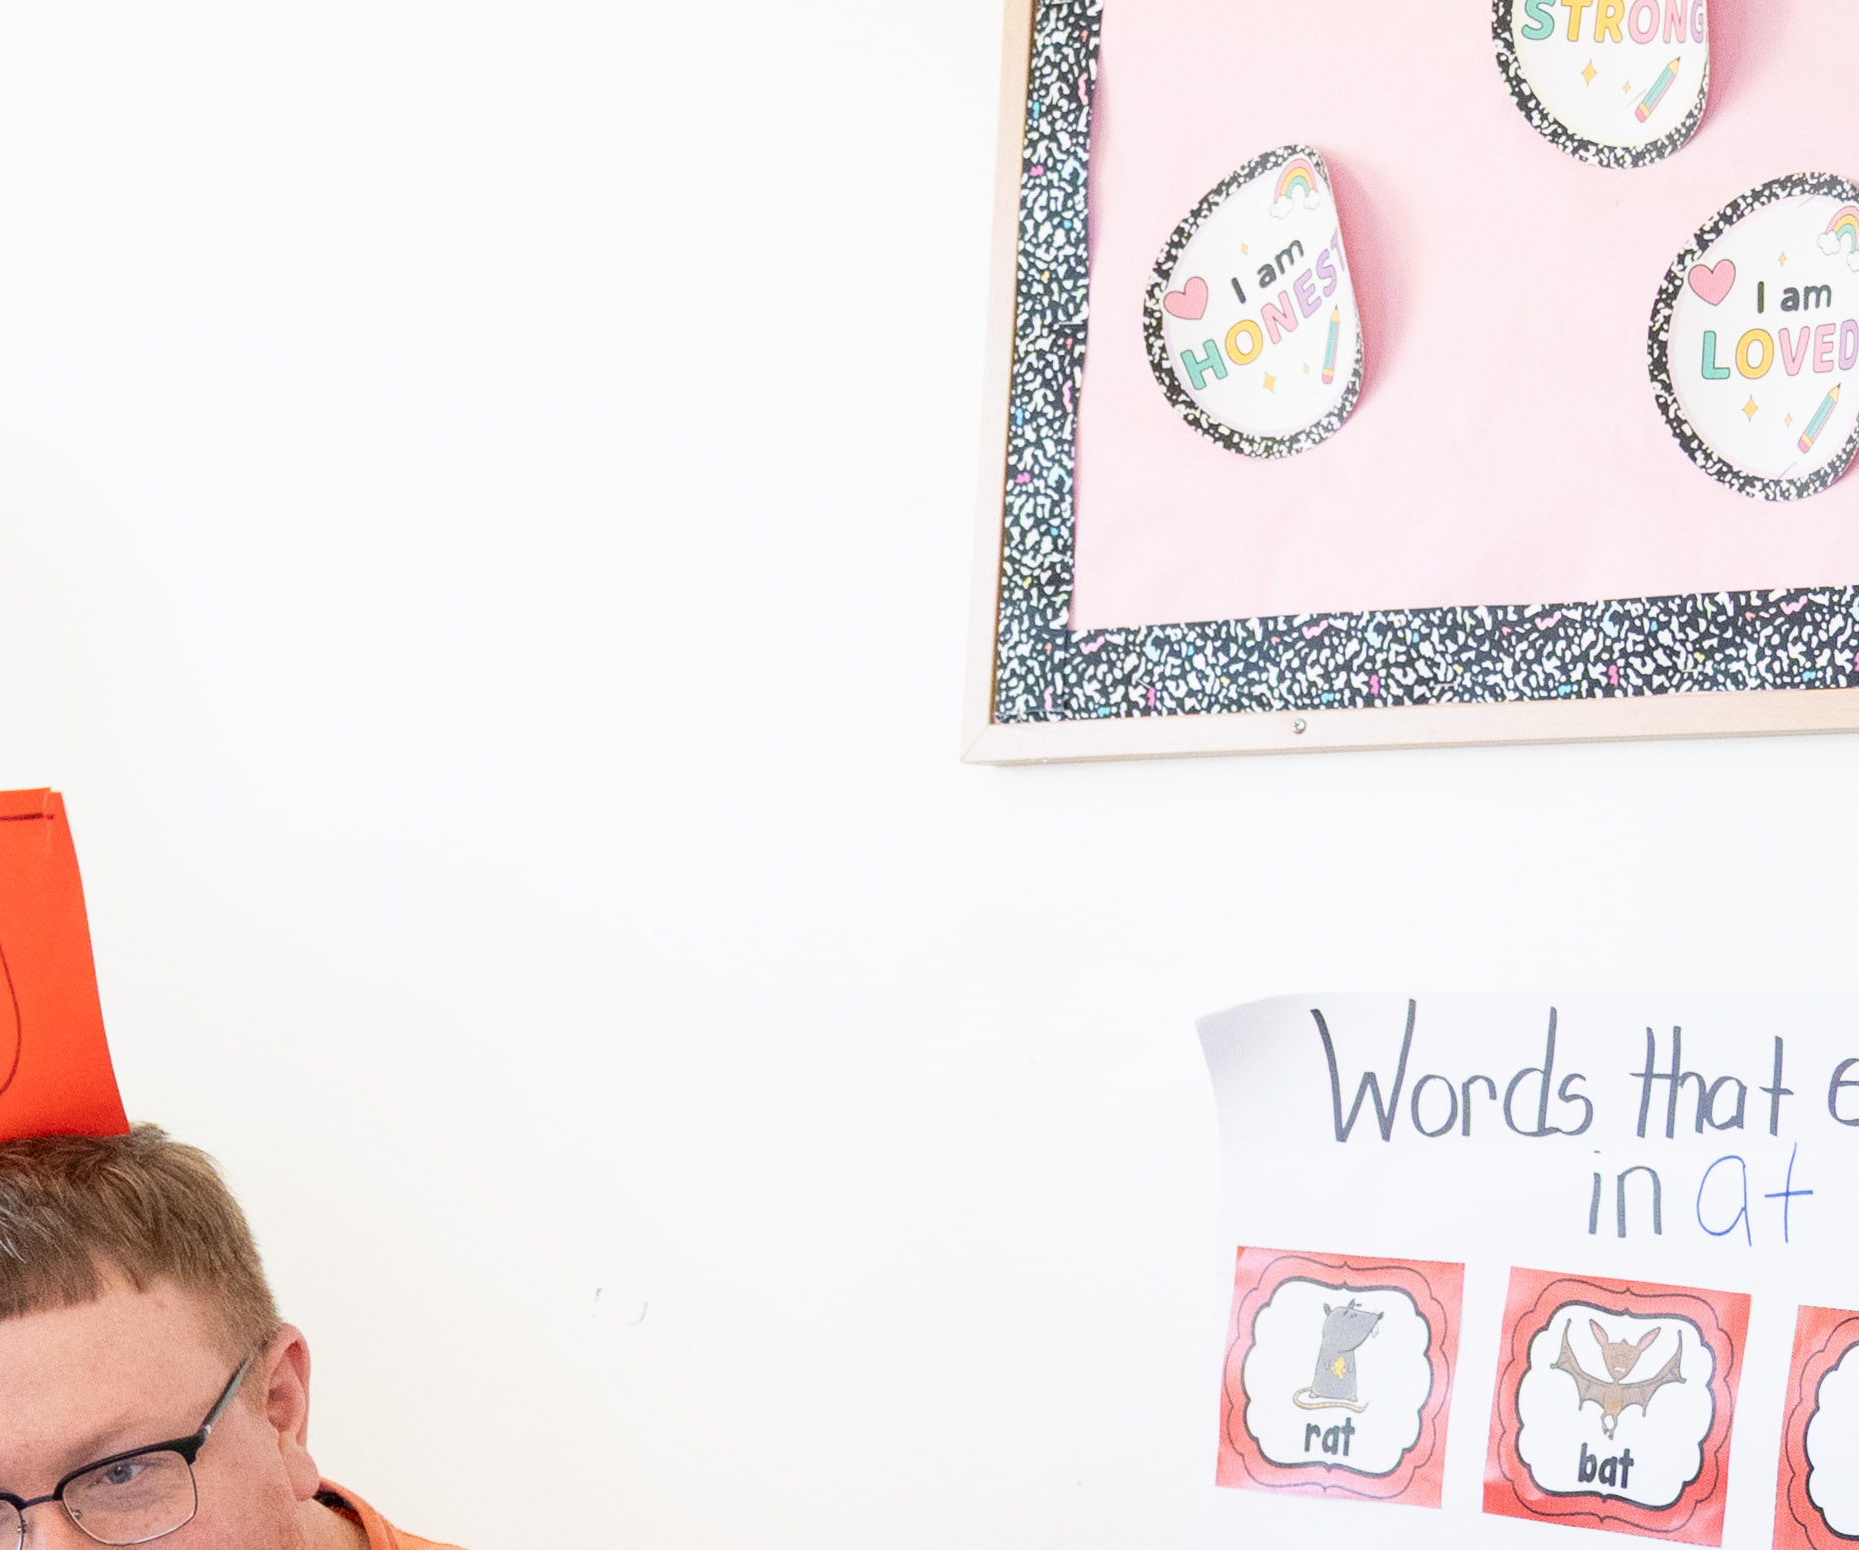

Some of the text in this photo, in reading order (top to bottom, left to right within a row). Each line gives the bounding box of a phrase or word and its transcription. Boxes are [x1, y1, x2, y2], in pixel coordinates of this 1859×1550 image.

[1522, 0, 1704, 44] STRONG
[1231, 240, 1304, 304] I am
[1757, 281, 1832, 314] I am
[1180, 226, 1345, 391] HONEST
[1701, 319, 1859, 380] LOVED
[1309, 998, 1594, 1142] Words
[1629, 1026, 1794, 1138] that
[1588, 1142, 1814, 1246] in at
[1304, 1417, 1355, 1456] rat
[1578, 1443, 1634, 1488] bat
